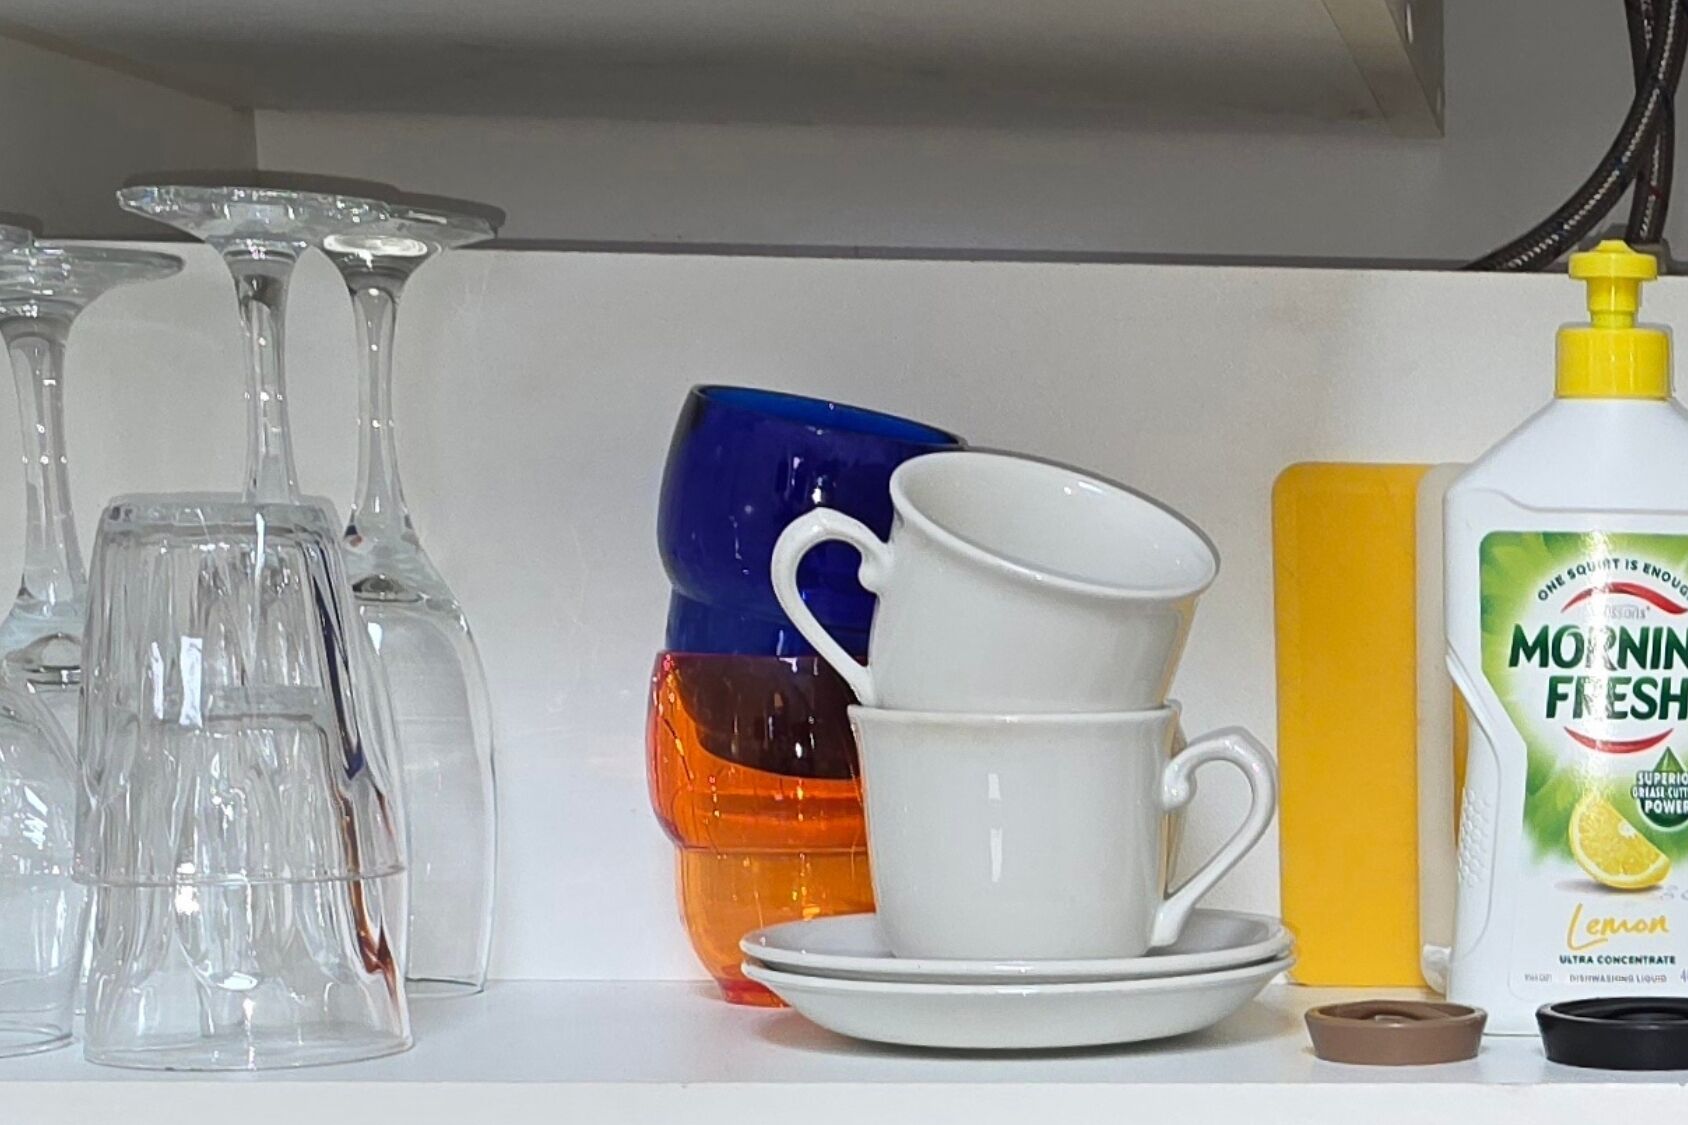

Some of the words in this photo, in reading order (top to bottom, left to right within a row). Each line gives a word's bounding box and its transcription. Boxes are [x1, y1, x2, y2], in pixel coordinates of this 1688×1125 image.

[1538, 575, 1566, 602] ONE
[1625, 558, 1638, 571] IS
[1567, 903, 1670, 951] Lemon
[1559, 954, 1594, 965] ULTRA
[1596, 954, 1677, 966] CONCENTRATE
